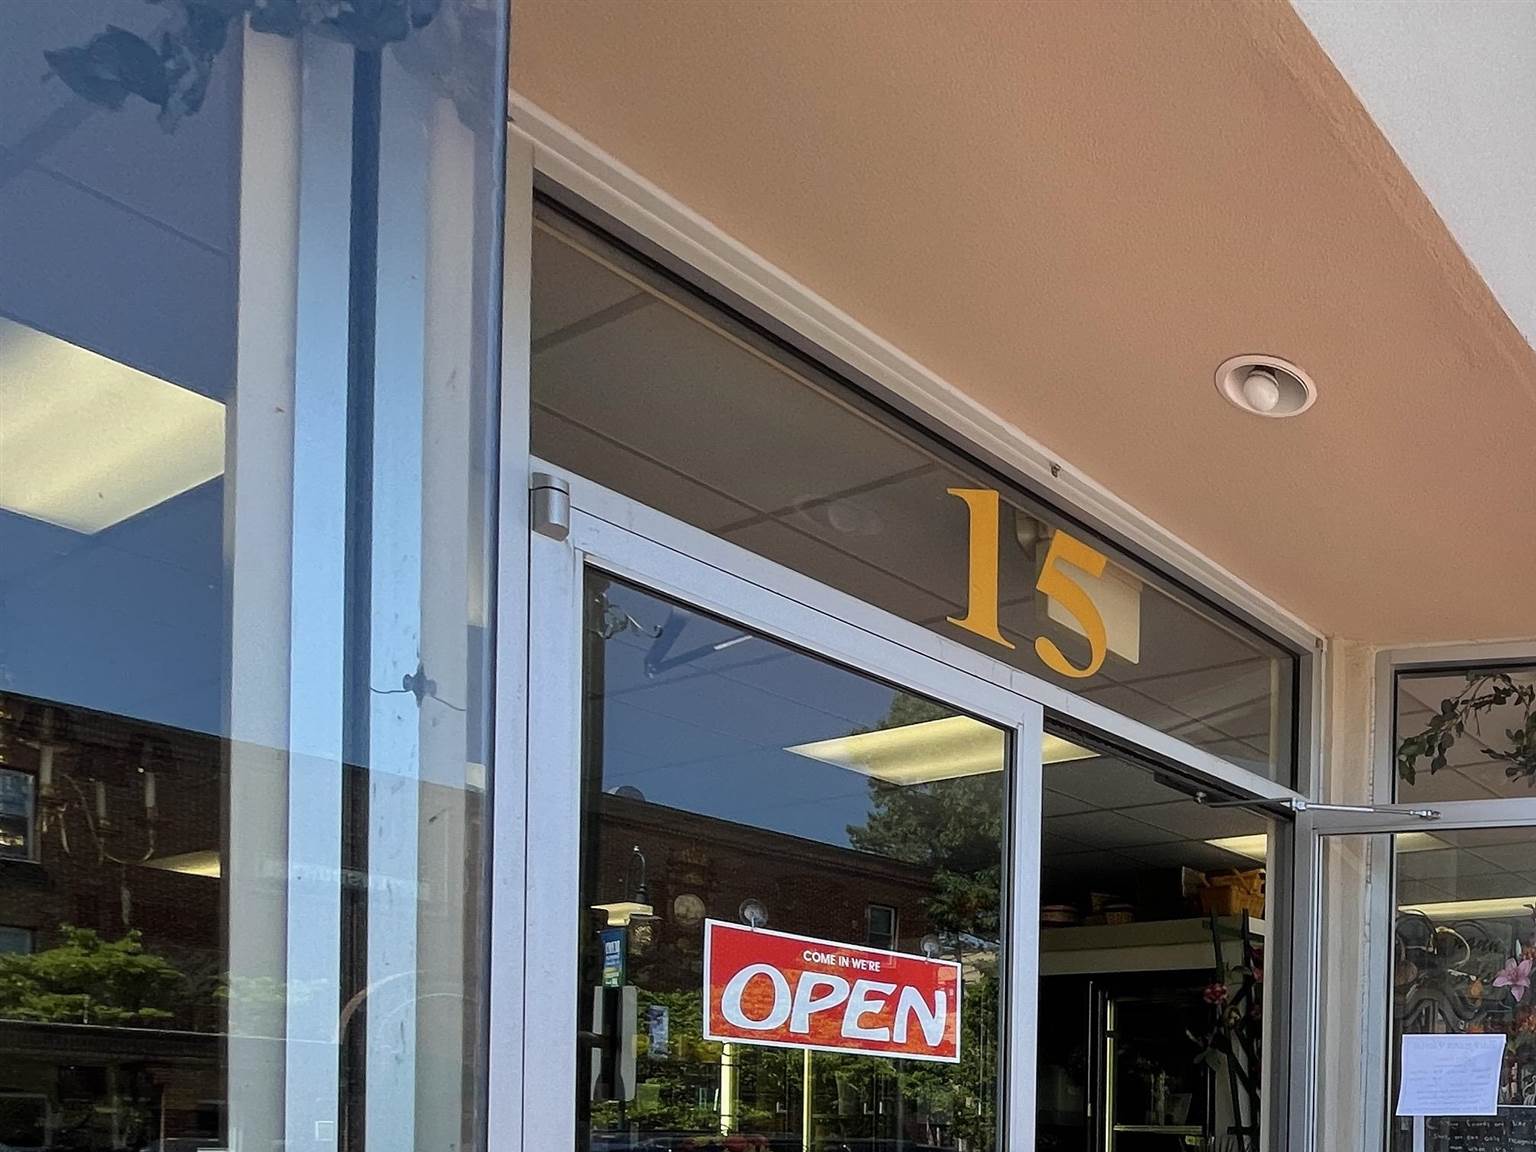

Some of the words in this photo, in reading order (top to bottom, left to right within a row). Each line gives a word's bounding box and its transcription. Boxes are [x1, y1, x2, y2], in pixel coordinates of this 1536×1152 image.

[945, 487, 1108, 678] 15
[803, 949, 836, 966] COME
[838, 956, 850, 968] IN
[851, 957, 881, 973] WE'RE
[720, 963, 947, 1047] OPEN
